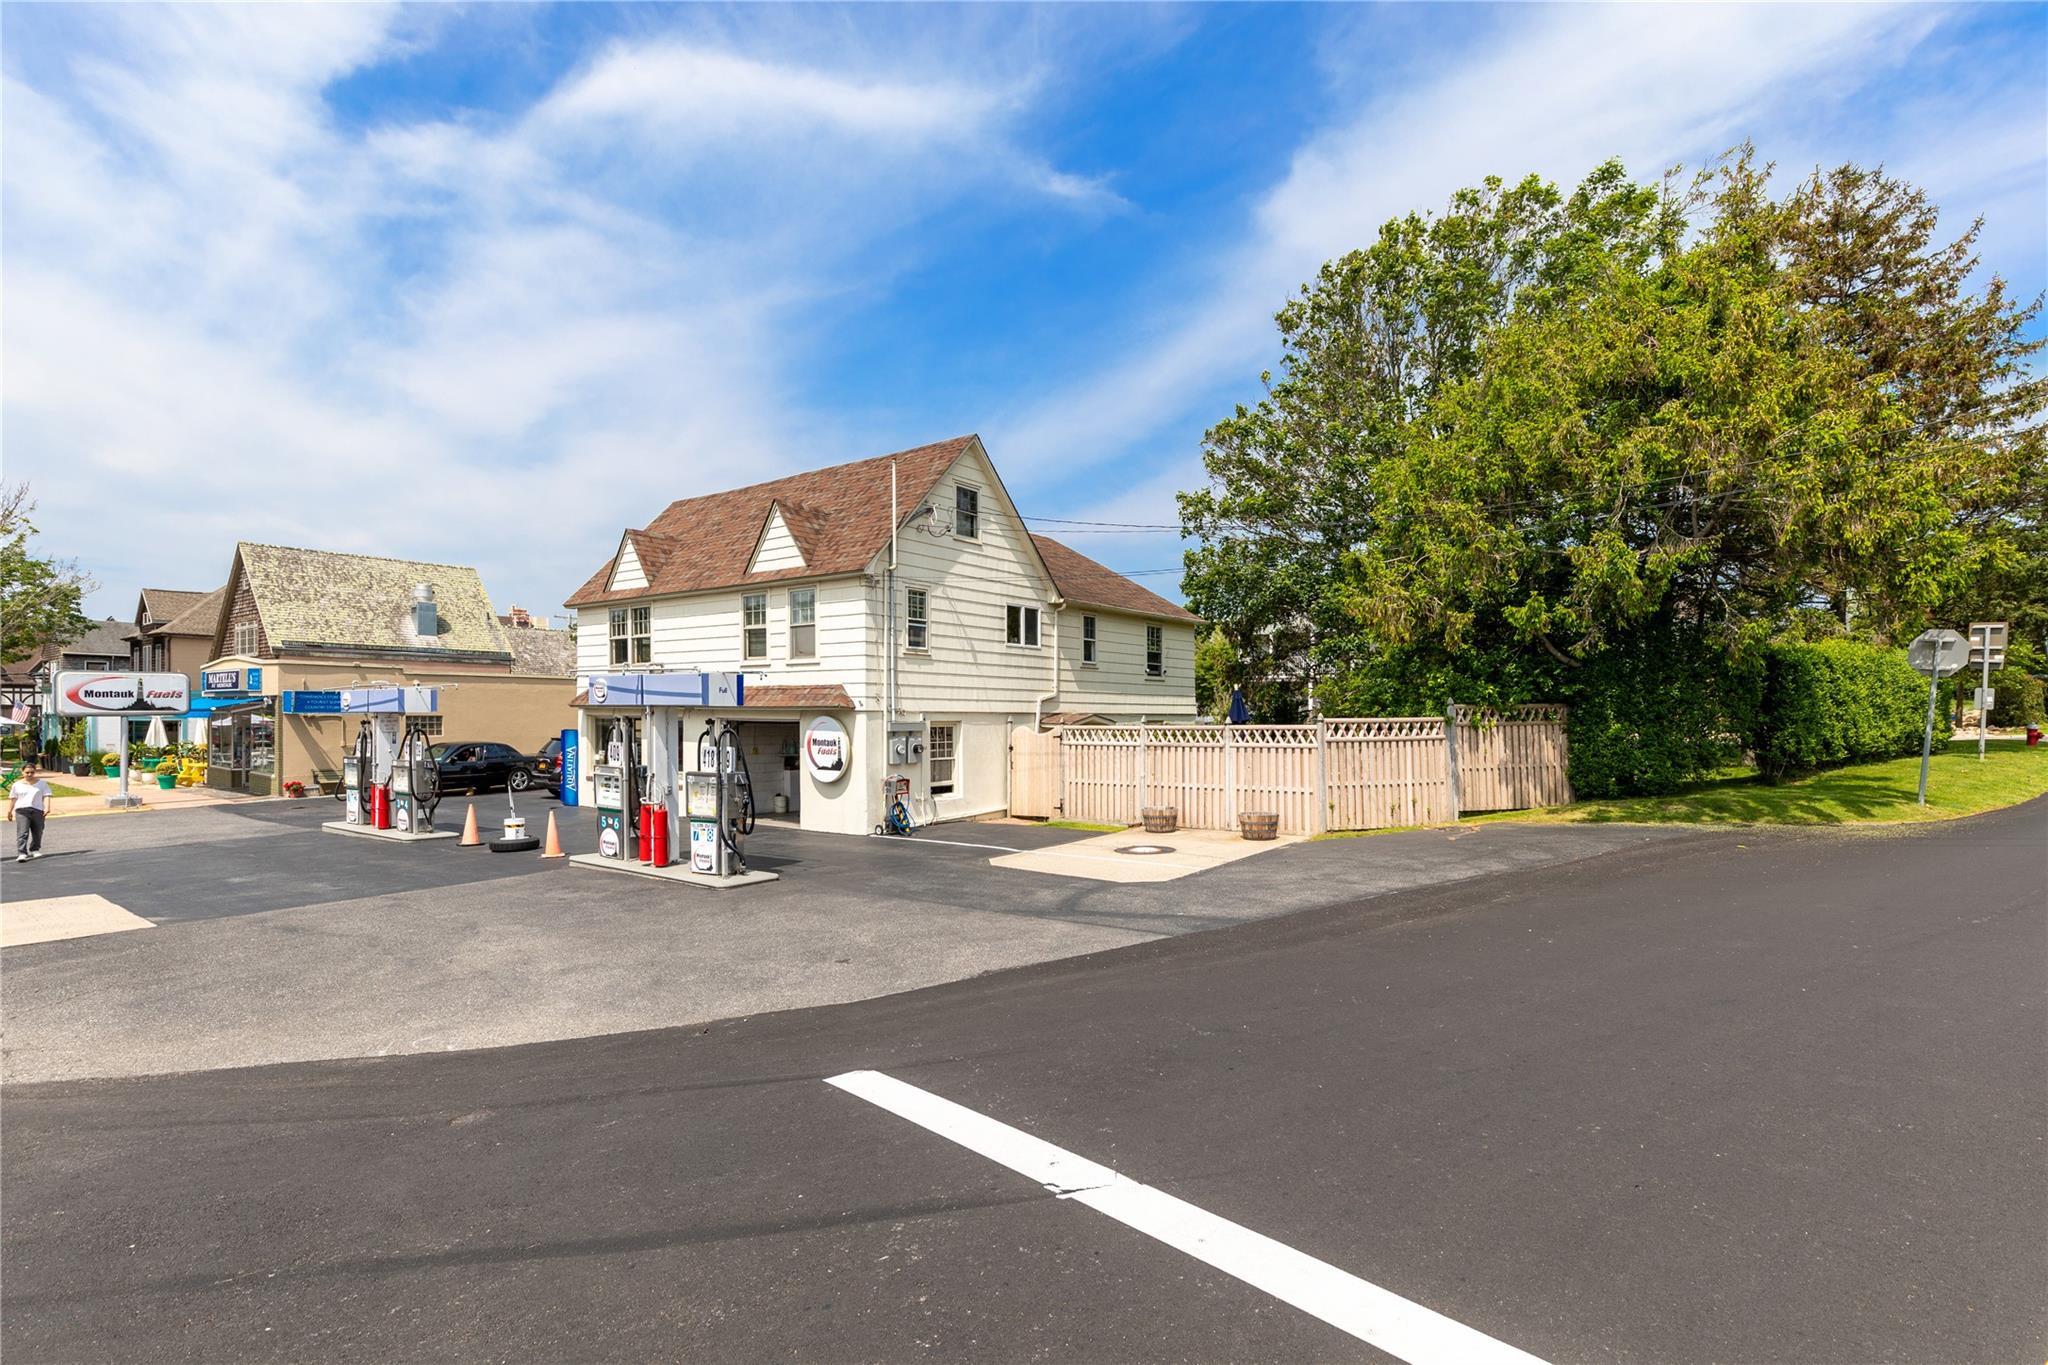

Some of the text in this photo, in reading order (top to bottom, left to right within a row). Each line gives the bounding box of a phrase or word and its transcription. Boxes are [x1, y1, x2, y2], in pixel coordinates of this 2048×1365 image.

[84, 690, 183, 699] Montauk Fuels
[812, 738, 837, 747] Montauk
[609, 744, 620, 761] 409
[702, 749, 715, 768] 418
[565, 745, 576, 792] AQUAFINA
[601, 815, 620, 830] 5 6
